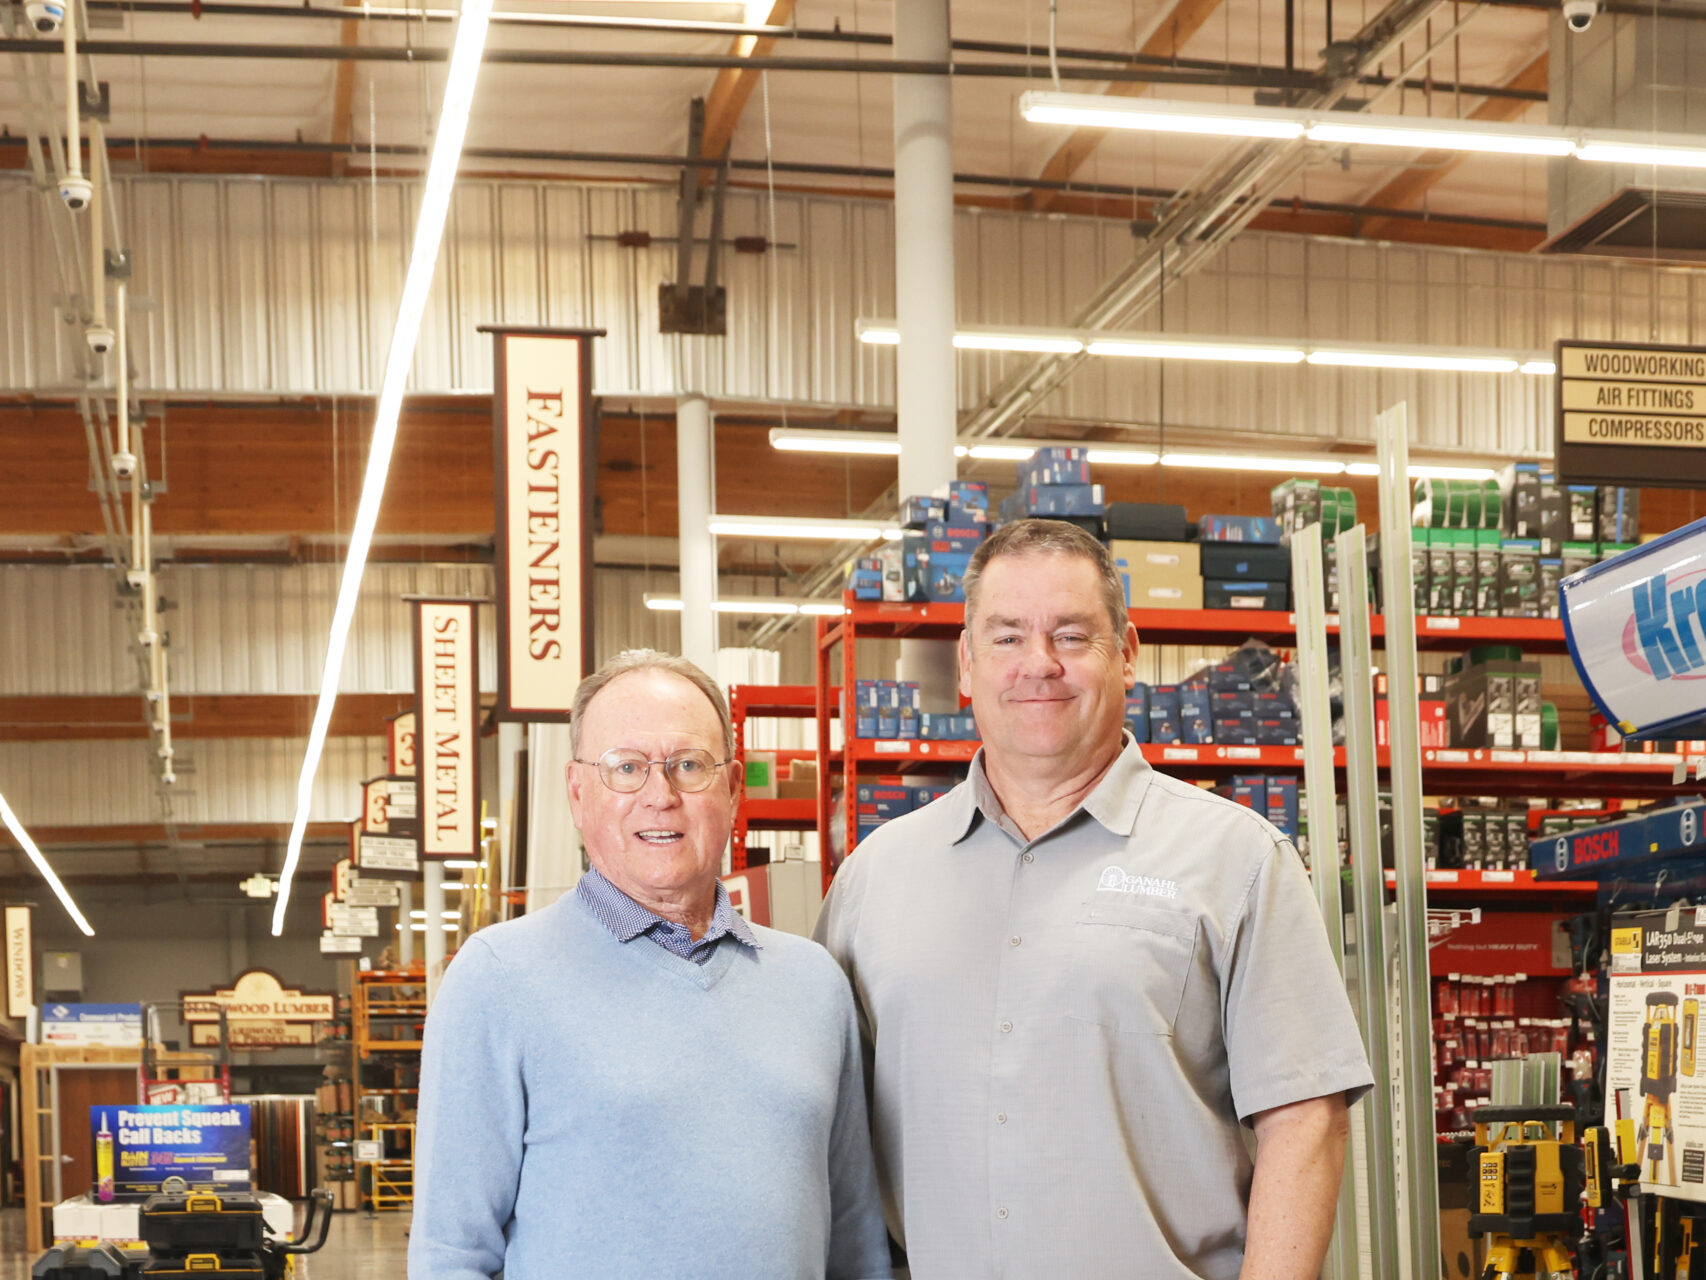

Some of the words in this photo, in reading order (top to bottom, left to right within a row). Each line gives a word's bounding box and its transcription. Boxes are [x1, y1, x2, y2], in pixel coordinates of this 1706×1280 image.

[1584, 353, 1705, 377] WOODWORKING
[1597, 386, 1622, 405] AIR
[1627, 388, 1694, 409] FITTINGS
[1589, 417, 1705, 441] COMPRESSORS
[526, 386, 563, 662] FASTENERS
[433, 615, 459, 722] SHEET
[435, 731, 460, 842] METAL
[1573, 820, 1619, 865] BOSCH
[1123, 883, 1176, 899] LUMBER
[1125, 875, 1178, 891] GANAHL
[274, 1002, 330, 1014] LUMBER
[118, 1110, 180, 1126] Prevent
[181, 1109, 241, 1128] Squeak
[118, 1128, 151, 1144] Call
[152, 1128, 202, 1144] Backs
